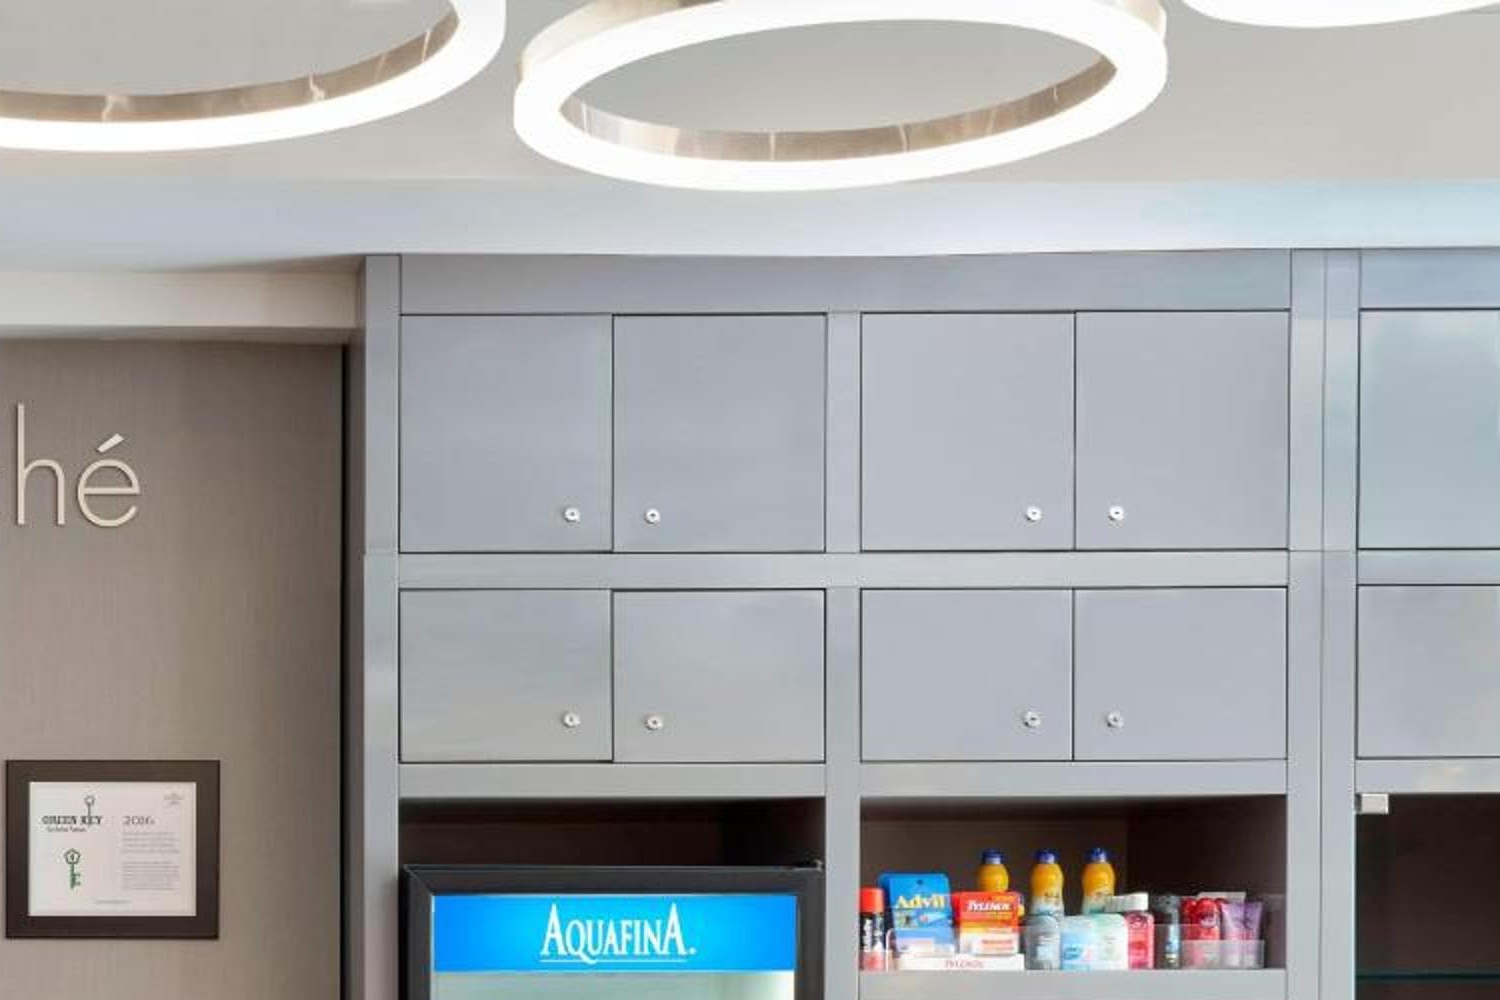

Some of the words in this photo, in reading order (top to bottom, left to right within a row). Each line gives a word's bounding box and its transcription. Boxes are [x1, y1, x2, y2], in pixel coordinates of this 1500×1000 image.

[41, 815, 77, 825] GREEN
[123, 815, 155, 825] 2016
[895, 893, 945, 909] Advil
